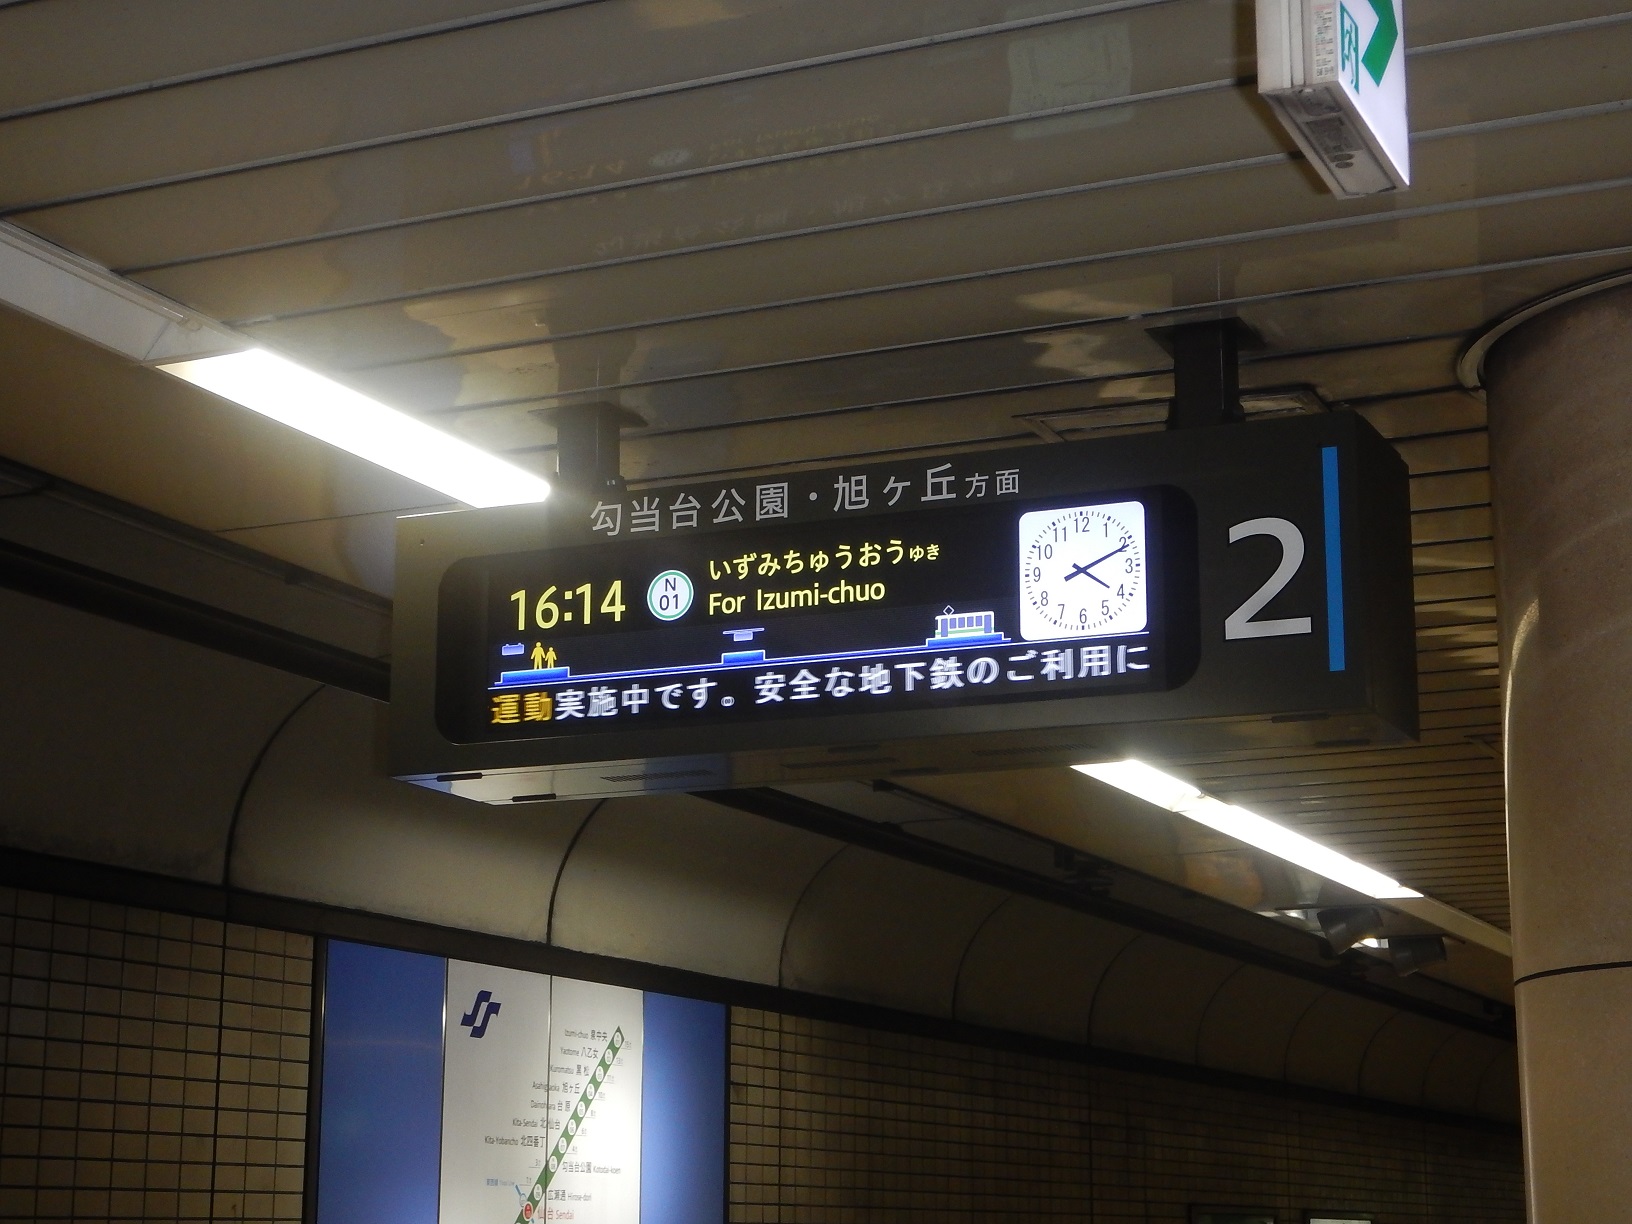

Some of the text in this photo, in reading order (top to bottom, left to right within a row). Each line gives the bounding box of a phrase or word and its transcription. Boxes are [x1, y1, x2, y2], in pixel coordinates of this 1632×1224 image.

[1074, 516, 1090, 533] 12
[1103, 522, 1108, 538] 1
[1053, 526, 1067, 542] 11
[1037, 544, 1053, 560] 10
[1118, 536, 1127, 553] 2
[1125, 558, 1133, 574] 3
[1033, 567, 1041, 582] 9
[1225, 517, 1311, 639] 2
[664, 577, 677, 592] N
[1116, 584, 1125, 599] 4
[510, 580, 626, 630] 16:14
[659, 593, 679, 611] 01
[708, 580, 886, 616] For Izumi-chuo
[1040, 591, 1049, 606] 8
[1058, 604, 1065, 619] 7
[1079, 608, 1087, 624] 6
[1101, 600, 1110, 616] 5
[556, 1208, 575, 1220] Sendai
